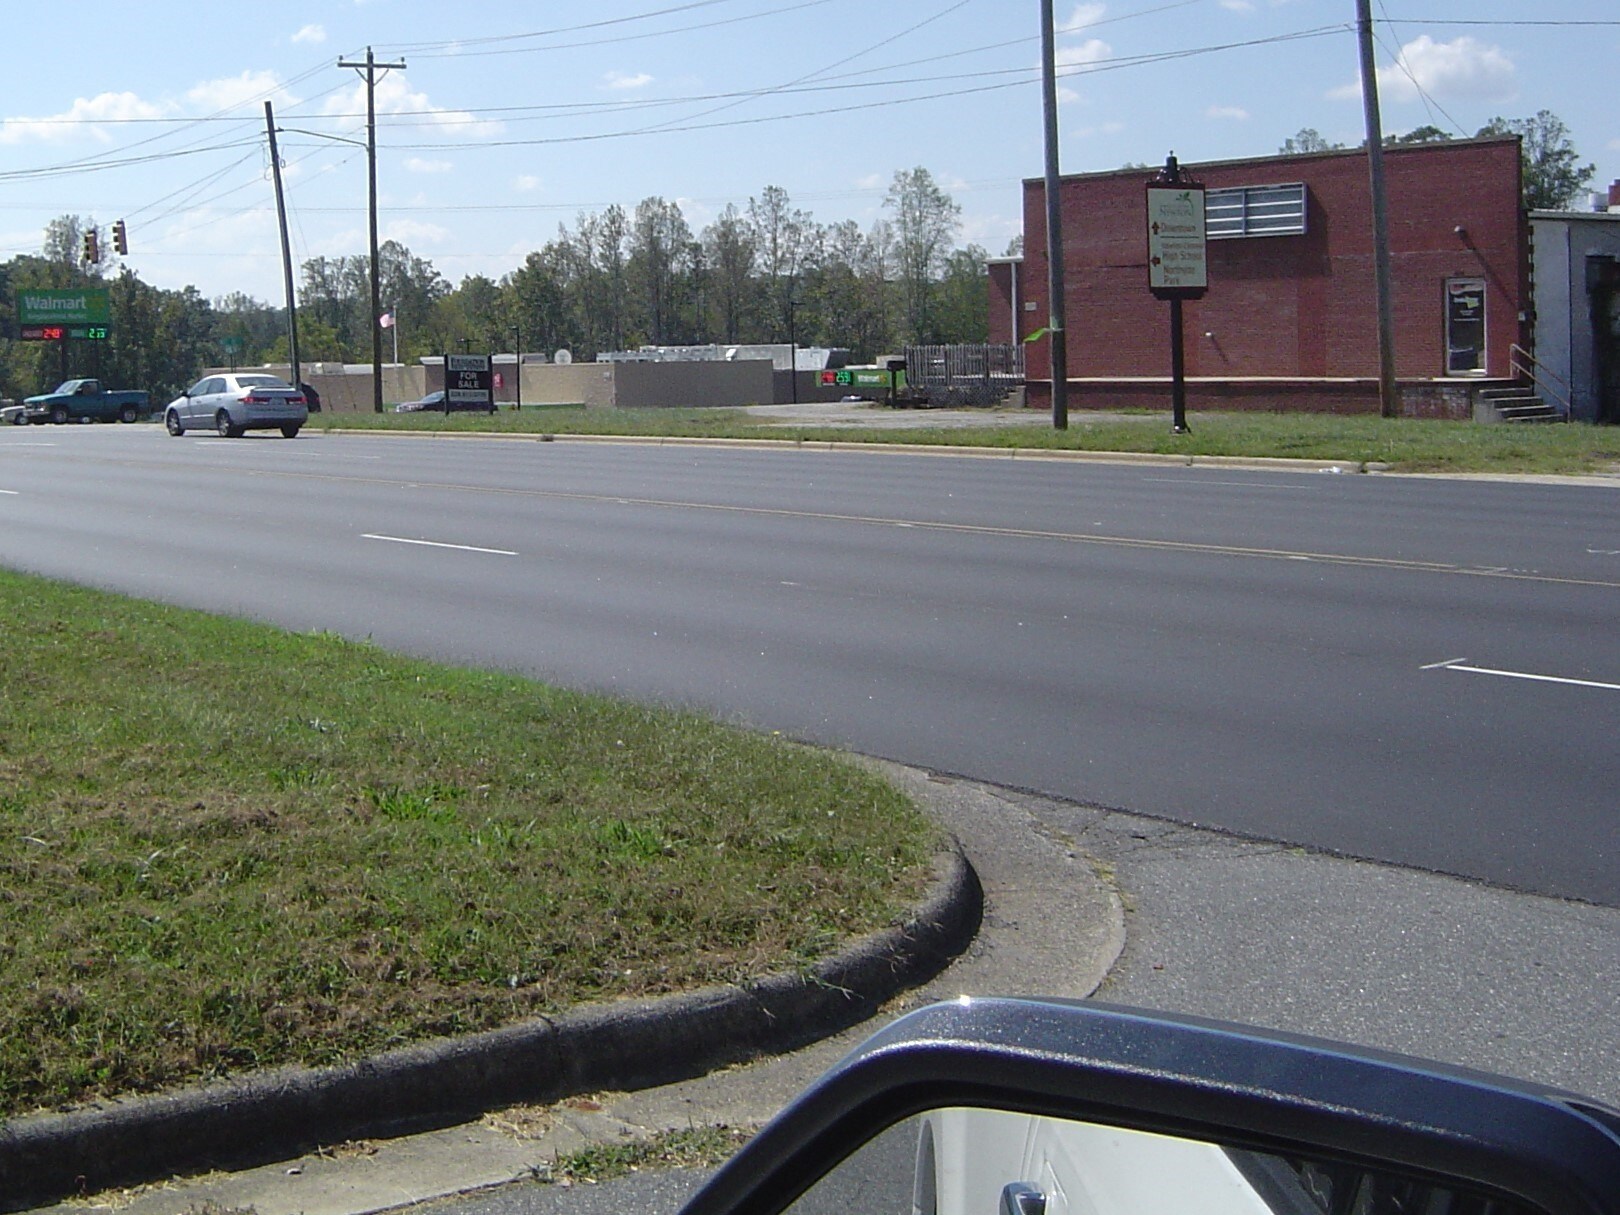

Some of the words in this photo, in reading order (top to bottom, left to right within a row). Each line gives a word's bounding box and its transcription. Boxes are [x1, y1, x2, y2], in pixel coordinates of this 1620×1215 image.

[25, 296, 87, 309] Walmart
[460, 372, 477, 380] FOR
[458, 380, 479, 389] SALE
